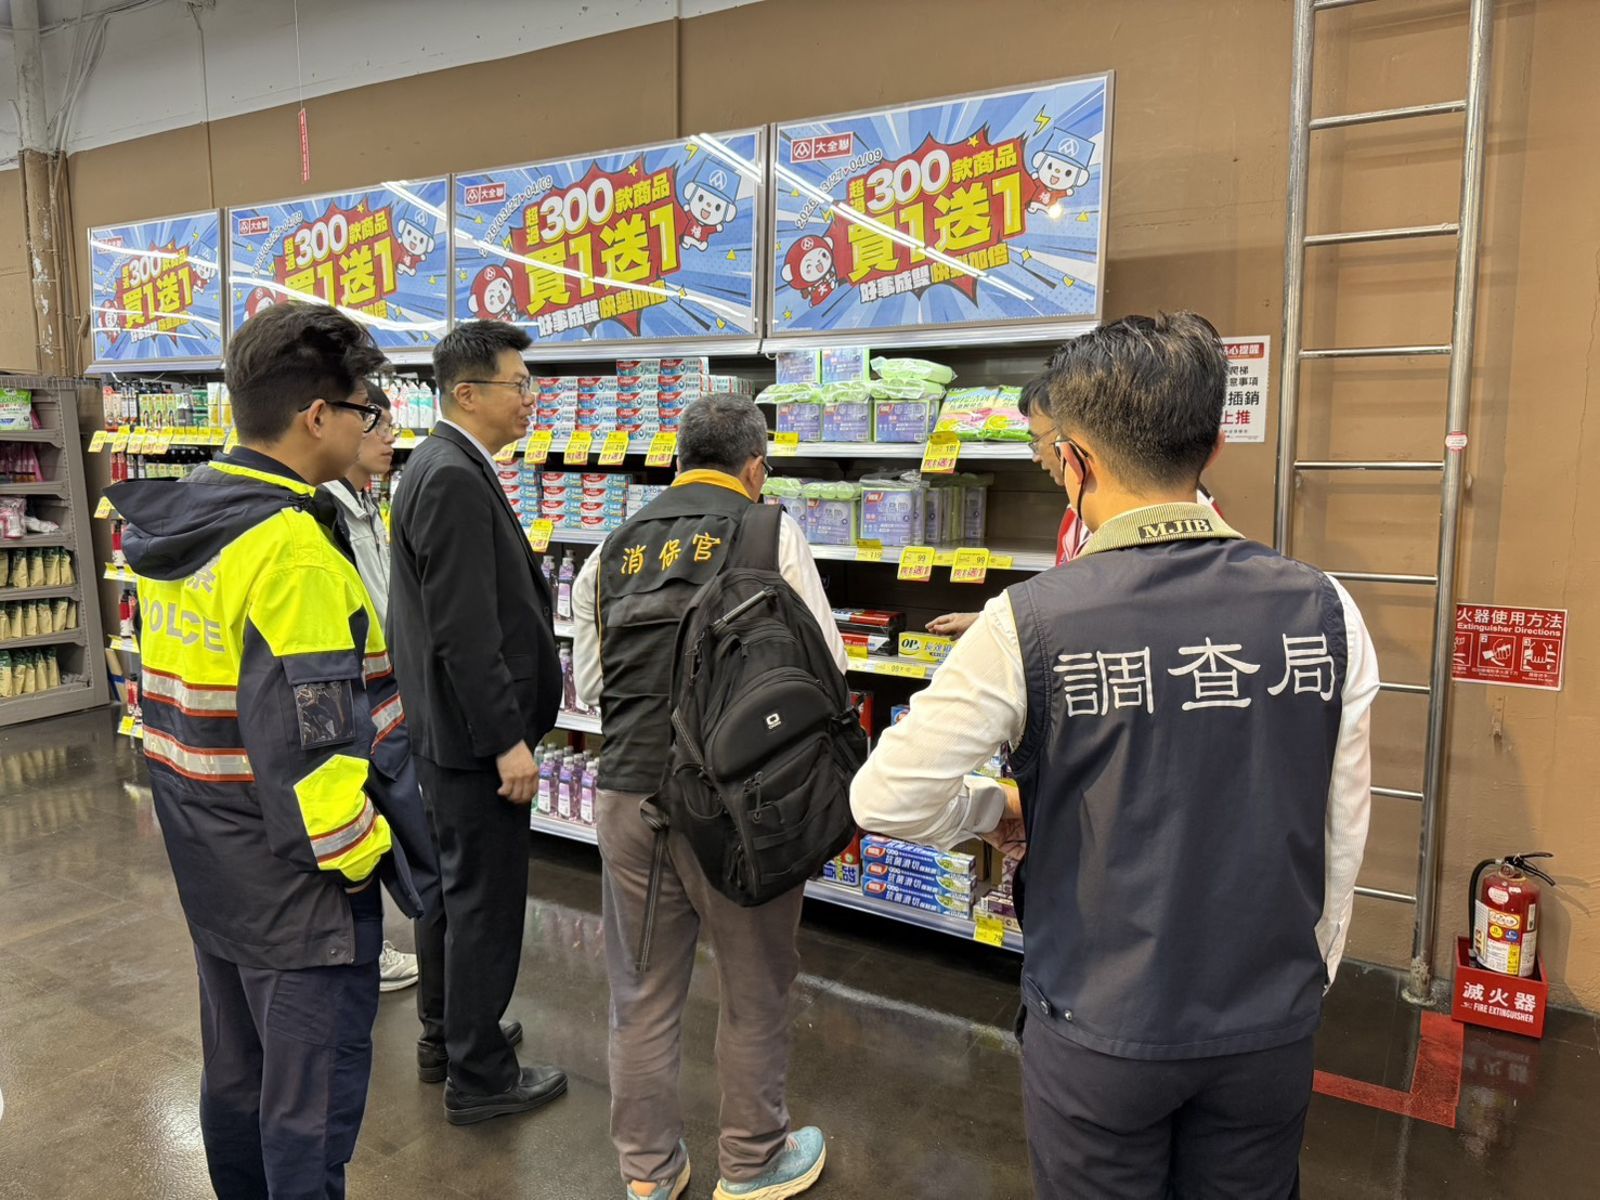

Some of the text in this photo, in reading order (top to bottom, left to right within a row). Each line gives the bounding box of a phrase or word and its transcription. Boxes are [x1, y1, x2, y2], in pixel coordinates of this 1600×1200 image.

[795, 167, 842, 230] 20263/27
[848, 171, 1024, 283] 買1送1
[524, 203, 677, 315] 買1送1
[621, 532, 721, 575] 消保官
[1457, 607, 1563, 629] 火器使用方法
[1457, 622, 1561, 637] Extinguisher Directions
[1053, 633, 1336, 717] 調查局
[1462, 982, 1536, 1013] 滅火器
[1473, 1002, 1534, 1023] FIRE EXTINGUISHER
